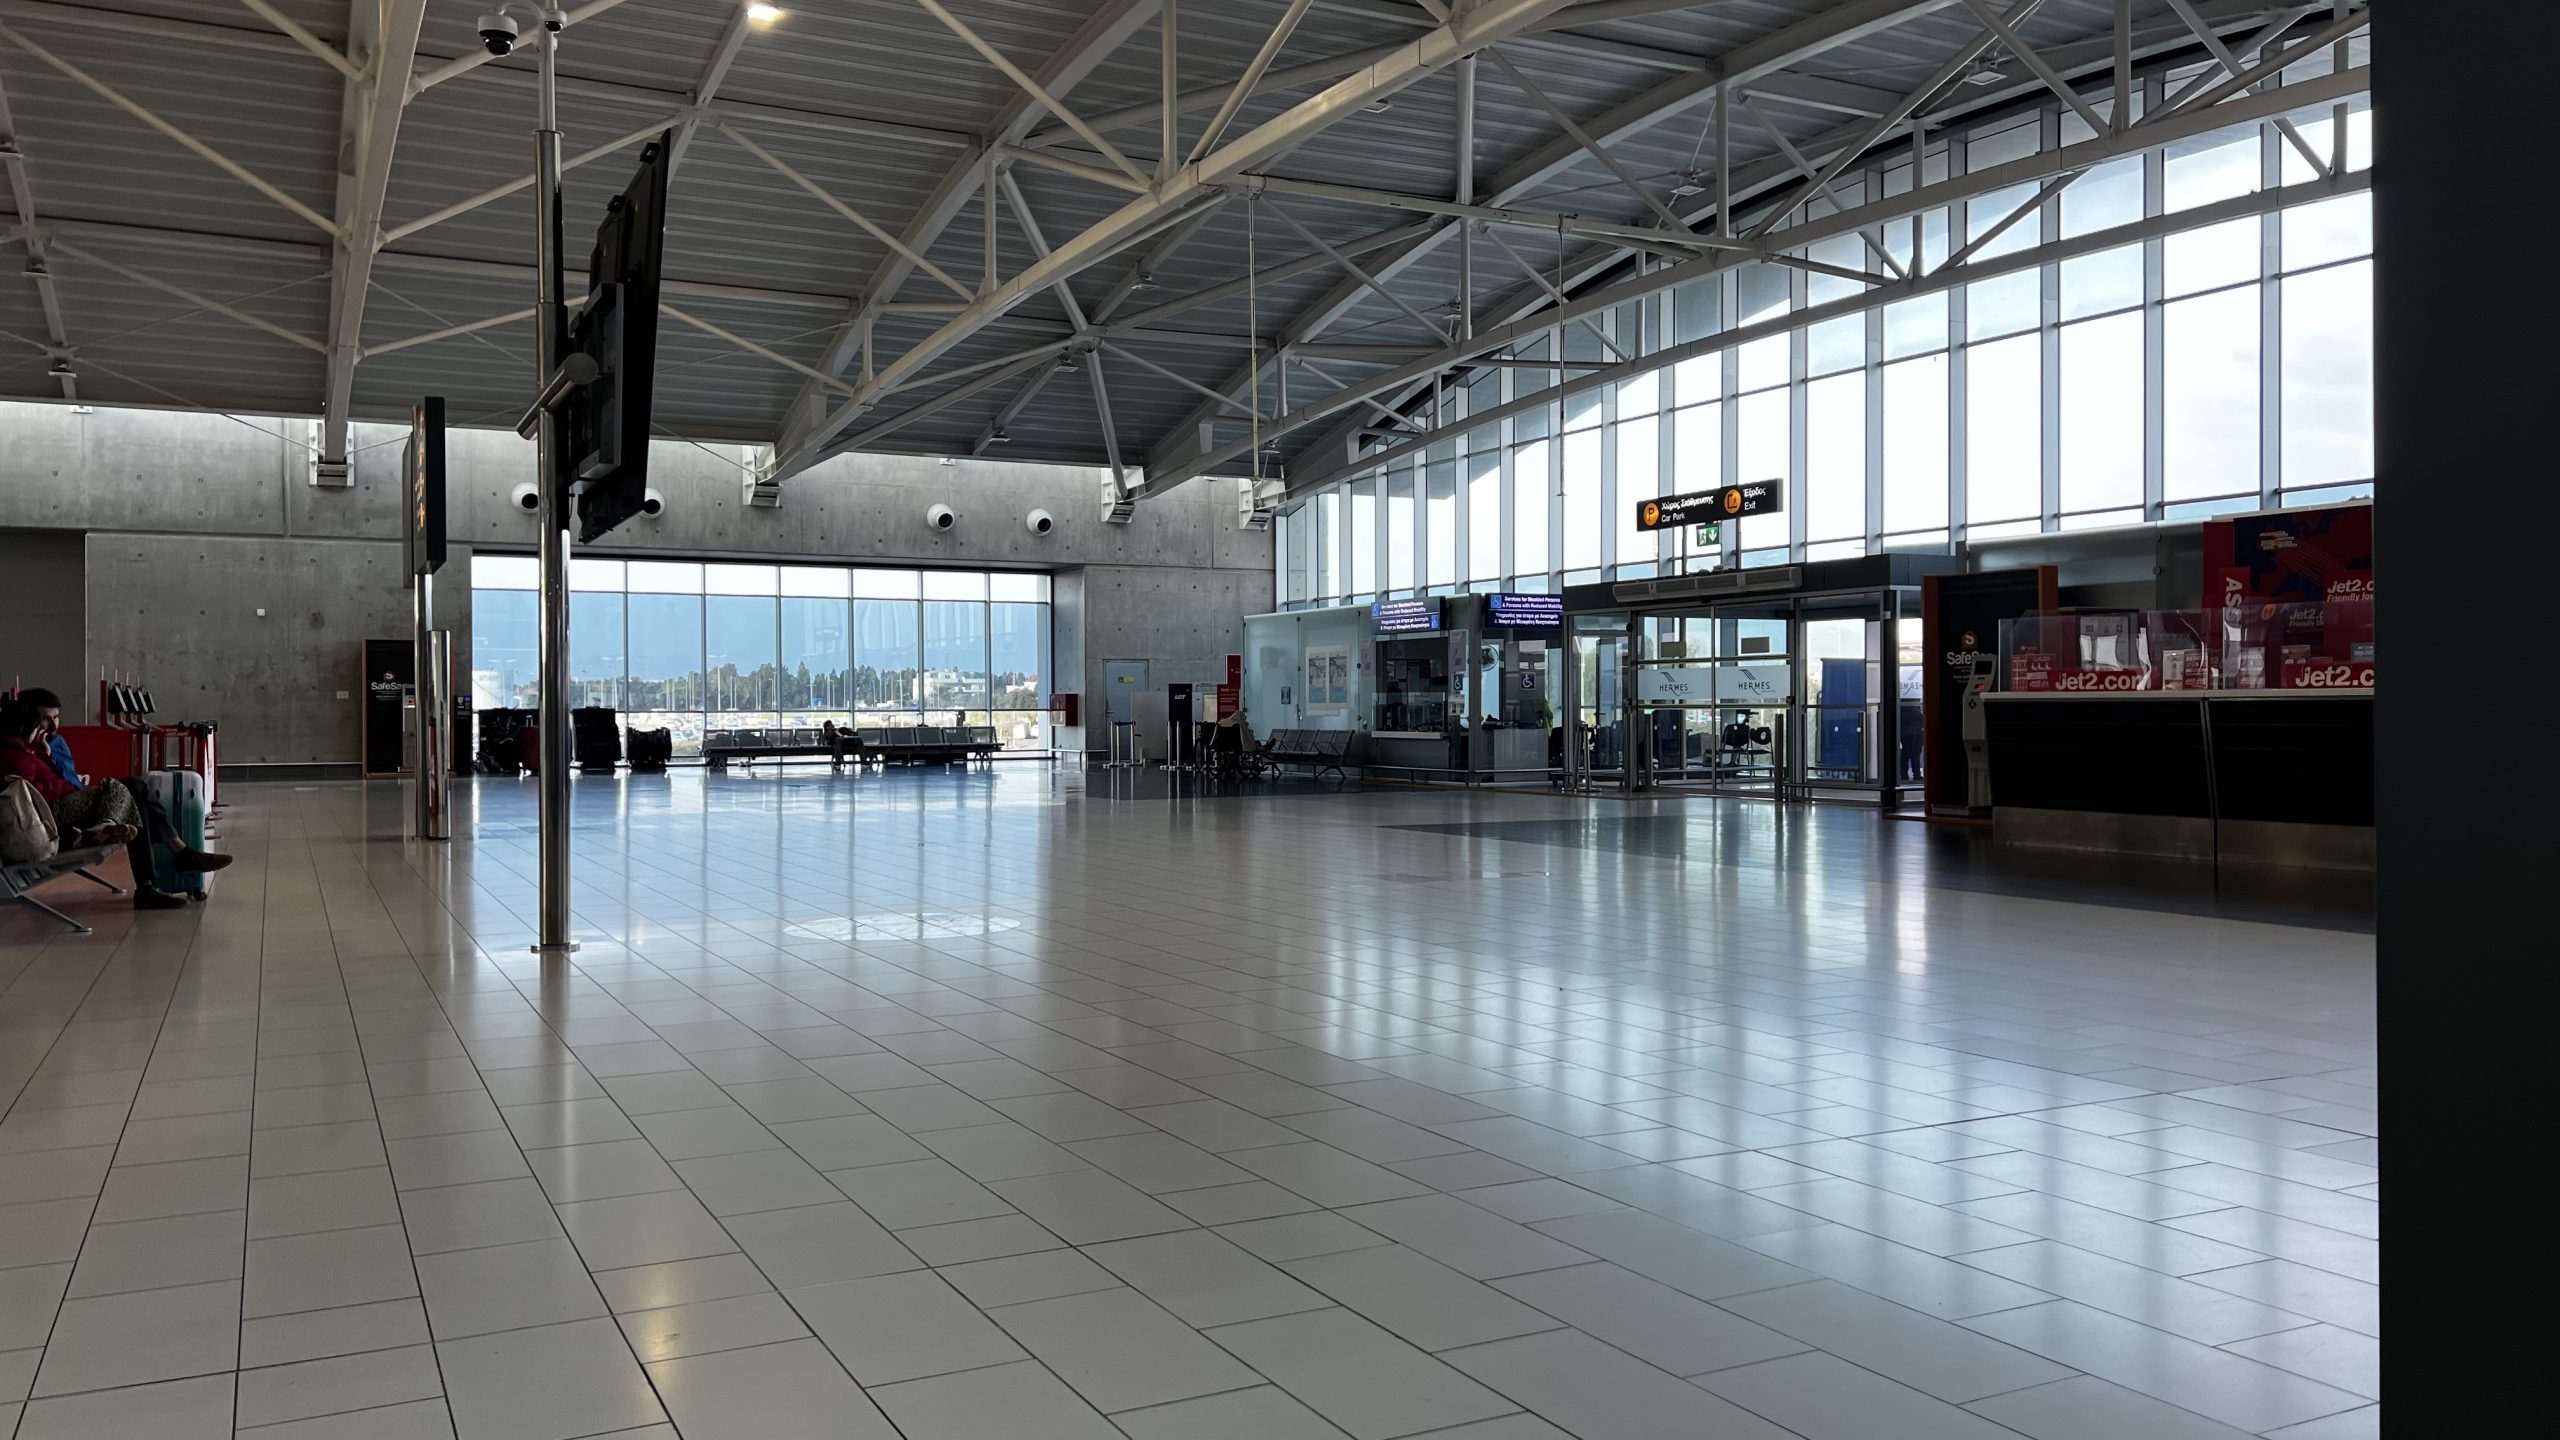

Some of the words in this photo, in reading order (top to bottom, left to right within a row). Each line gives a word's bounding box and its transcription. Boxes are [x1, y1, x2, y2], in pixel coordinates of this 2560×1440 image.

[1743, 487, 1766, 499] Έξοδος
[1744, 501, 1756, 510] Exit
[1648, 507, 1654, 521] P
[1661, 514, 1671, 522] Car
[1673, 512, 1685, 521] Park
[2326, 592, 2360, 602] Friendly
[1659, 683, 1689, 695] HERMES
[1738, 681, 1770, 694] HERMES
